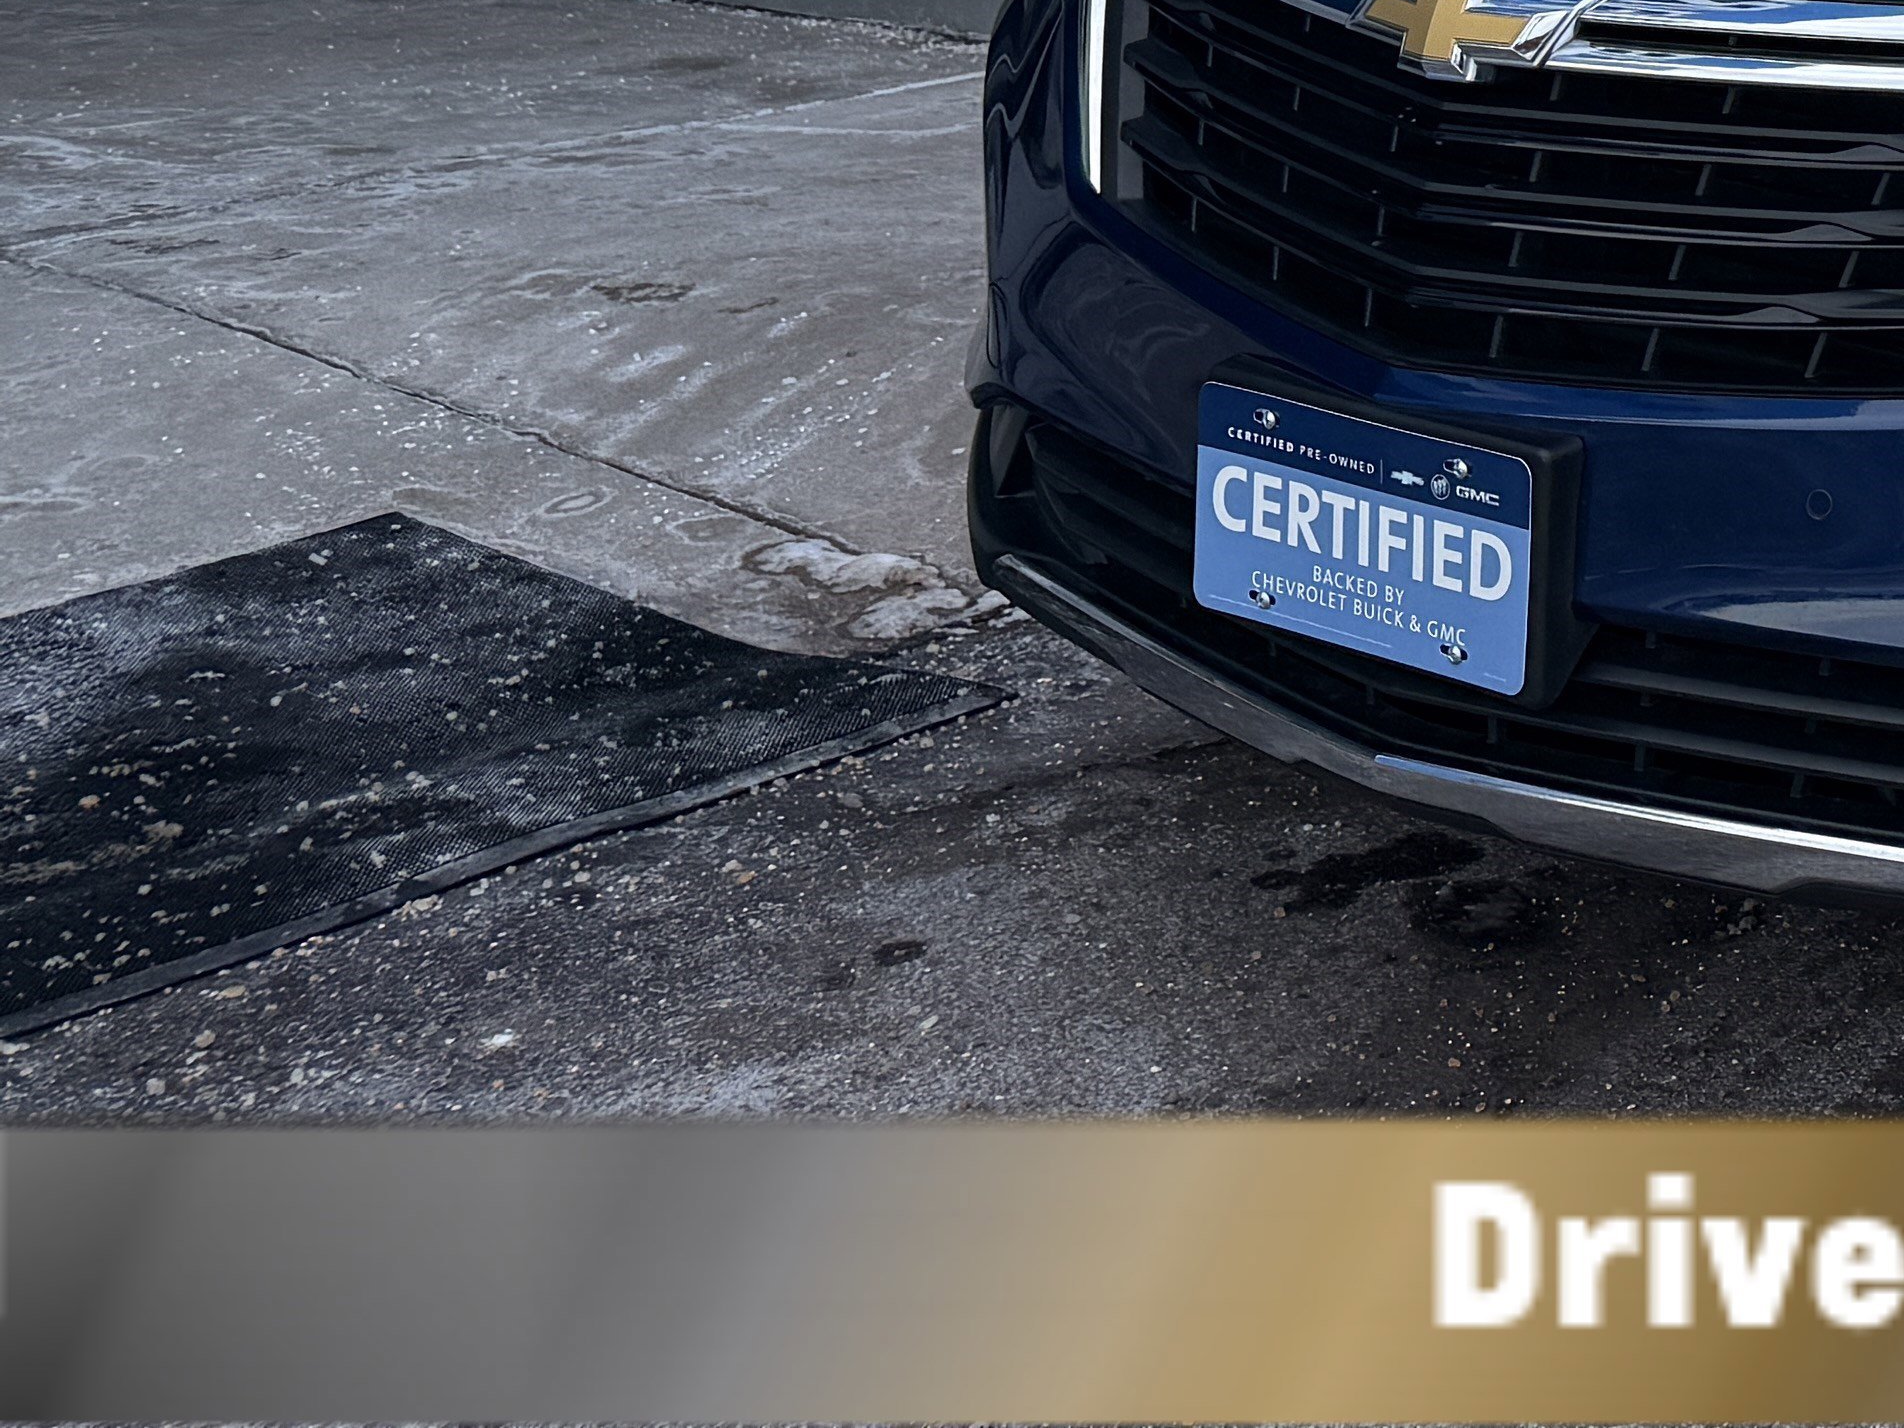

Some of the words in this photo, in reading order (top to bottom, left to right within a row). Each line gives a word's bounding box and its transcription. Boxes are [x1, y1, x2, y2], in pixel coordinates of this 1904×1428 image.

[1227, 426, 1295, 453] CERTIFIED
[1299, 444, 1375, 475] PRE-OWNED
[1456, 485, 1500, 507] GMC
[1212, 464, 1513, 602] CERTIFIED
[1251, 570, 1348, 612] CHEVROLET
[1352, 598, 1404, 629] BUICK
[1408, 614, 1421, 633] &
[1427, 619, 1467, 647] GMC
[1312, 564, 1379, 598] BACKED
[1384, 584, 1405, 606] BY
